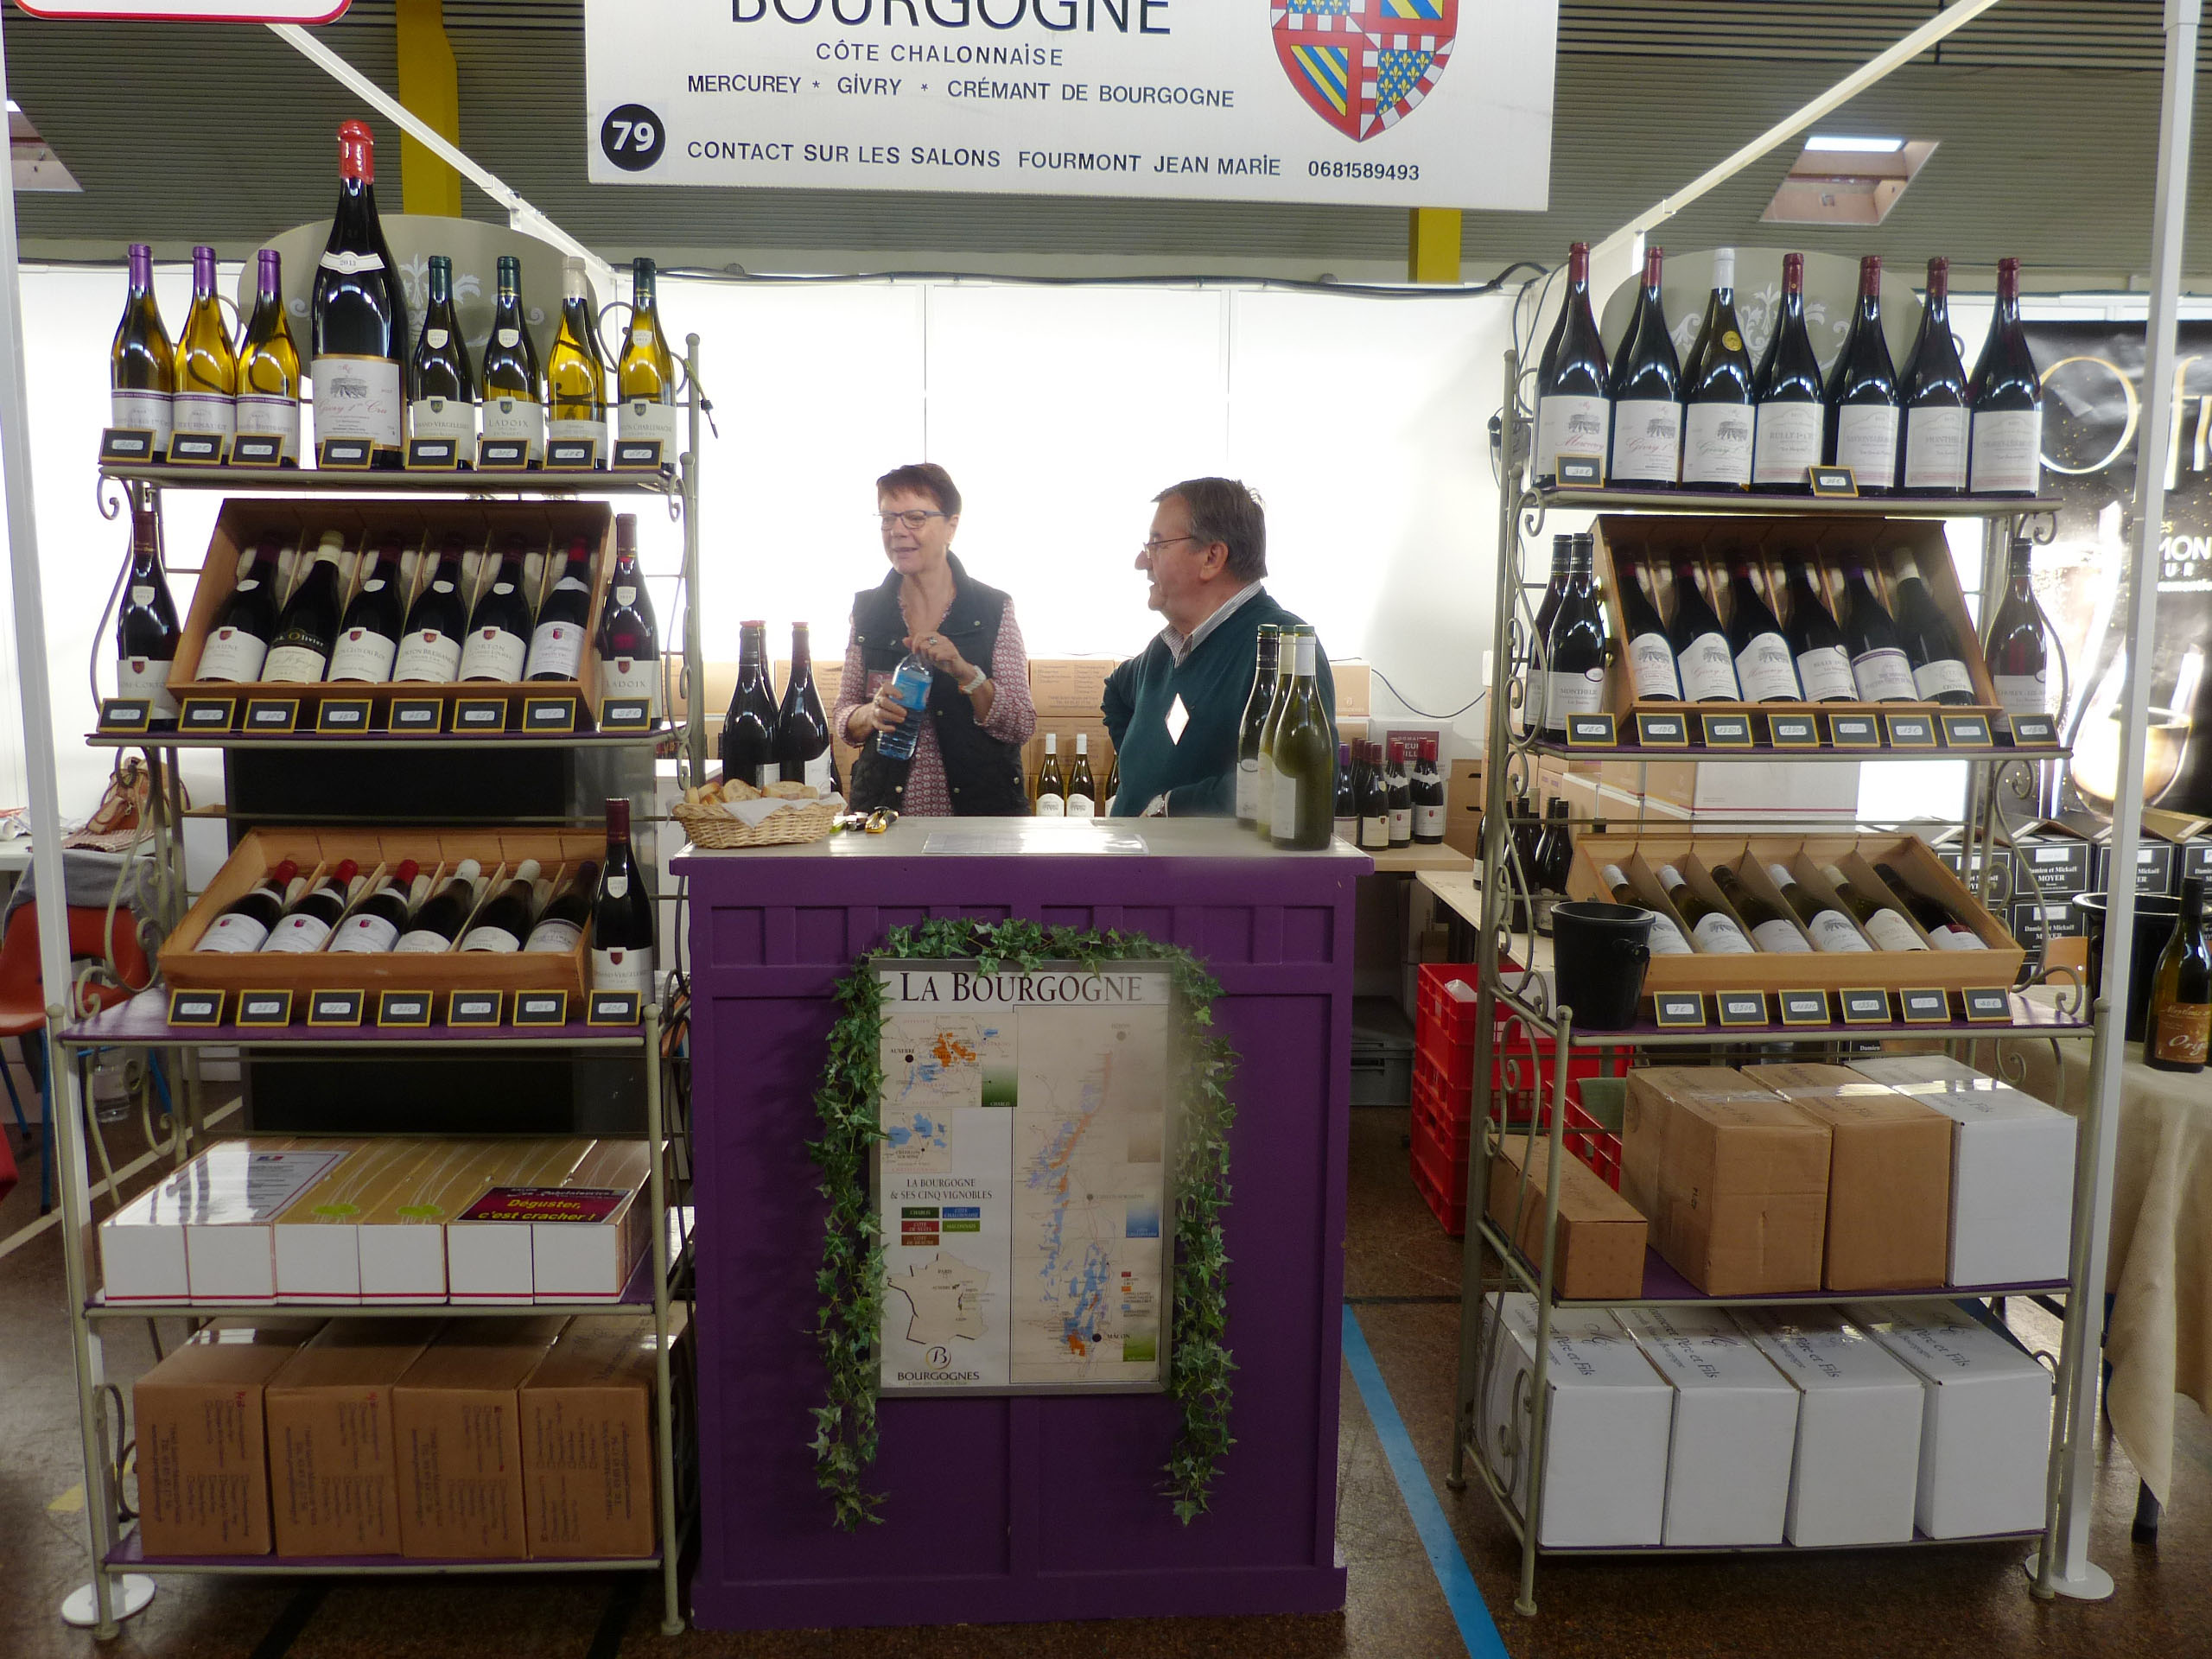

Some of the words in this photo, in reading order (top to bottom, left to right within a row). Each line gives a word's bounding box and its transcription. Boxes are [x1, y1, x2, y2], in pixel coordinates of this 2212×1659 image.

[817, 39, 880, 62] CÔTE
[688, 75, 801, 94] MERCUREY
[948, 76, 1051, 101] CRÉMANT
[1062, 84, 1088, 102] DE
[1099, 86, 1234, 108] BOURGOGNE
[612, 122, 655, 152] 79
[688, 142, 794, 162] CONTACT
[804, 145, 849, 164] SUR
[859, 147, 900, 165] LES
[912, 147, 1001, 168] SALONS
[1019, 151, 1141, 173] FOURMONT
[1154, 156, 1209, 175] JEAN
[1308, 161, 1420, 181] 0681589493
[489, 418, 529, 428] LADOIX
[607, 679, 645, 688] LADOIX
[899, 972, 940, 1001] LA
[952, 971, 1142, 1002] BOURGOGNE
[907, 1179, 918, 1187] LA
[920, 1179, 976, 1188] BOURGOGNE
[890, 1191, 898, 1199] &
[900, 1191, 916, 1199] SES
[918, 1191, 941, 1200] CINQ
[943, 1191, 993, 1199] VIGNOBLES
[506, 1198, 582, 1210] Déguster,
[478, 1211, 518, 1220] c'est
[522, 1211, 587, 1220] cracher
[1554, 1336, 1573, 1352] Père
[1573, 1362, 1596, 1376] Fils
[1674, 1338, 1694, 1353] Père
[1698, 1364, 1720, 1378] Fils
[1945, 1352, 1970, 1367] Fils
[898, 1371, 980, 1381] BOURGOGNES
[1818, 1363, 1841, 1377] Fils
